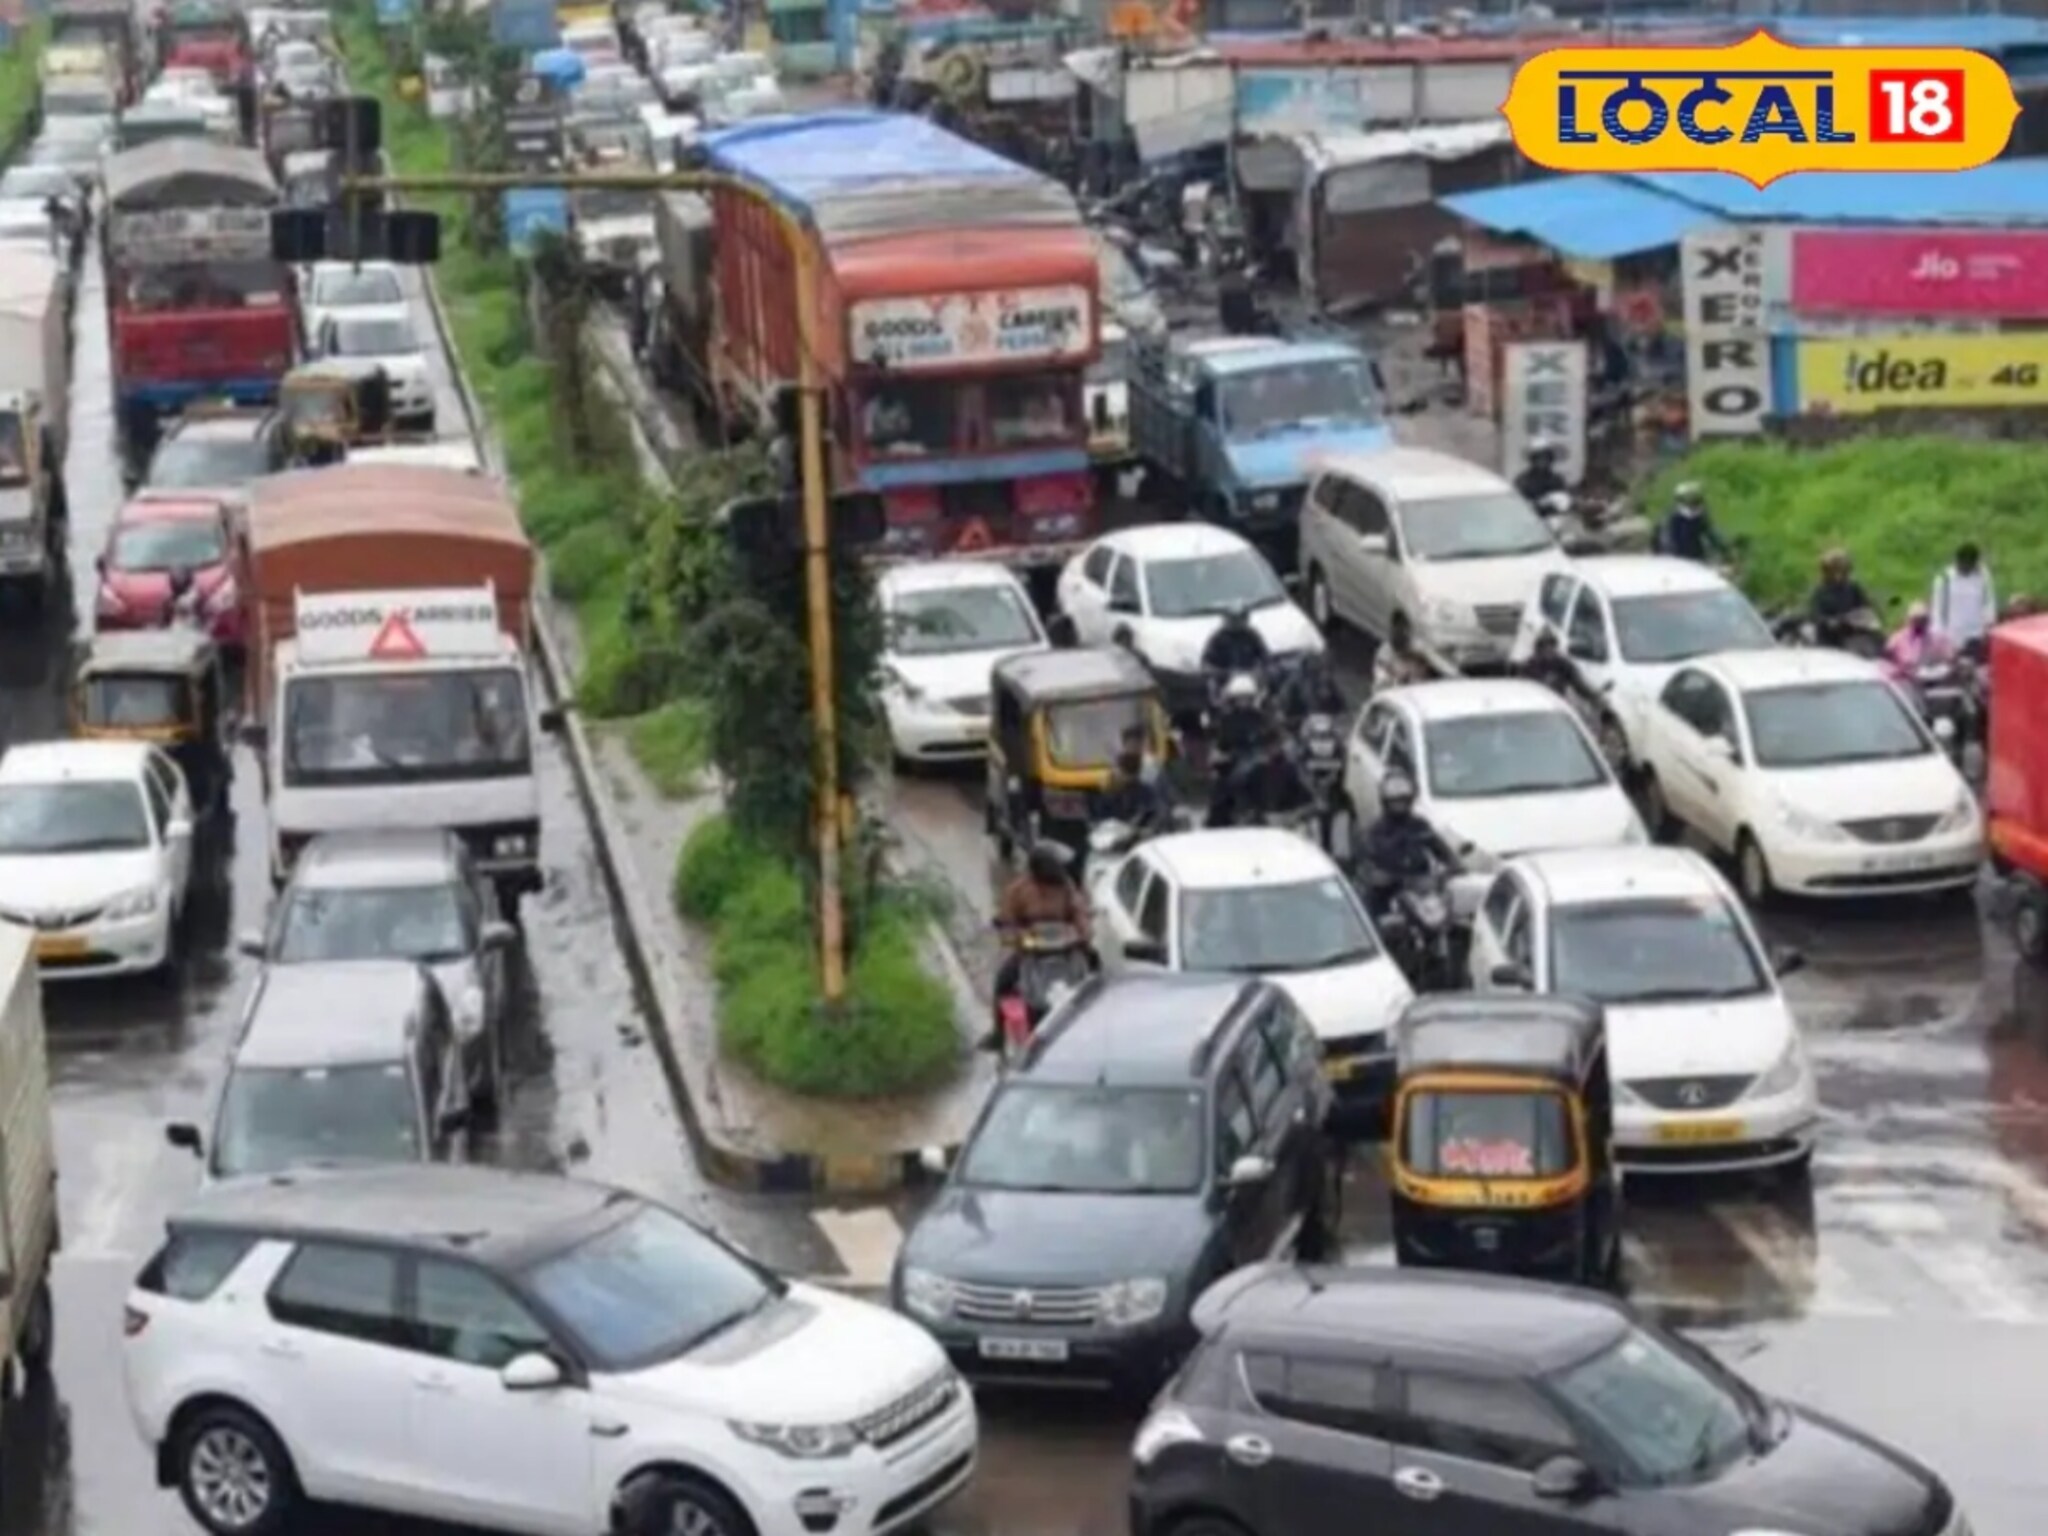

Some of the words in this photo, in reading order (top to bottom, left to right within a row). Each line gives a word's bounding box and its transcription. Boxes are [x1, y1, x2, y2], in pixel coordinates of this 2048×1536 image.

[1909, 252, 1960, 280] Jio
[1990, 363, 2039, 387] 4G
[301, 607, 382, 629] GOODS
